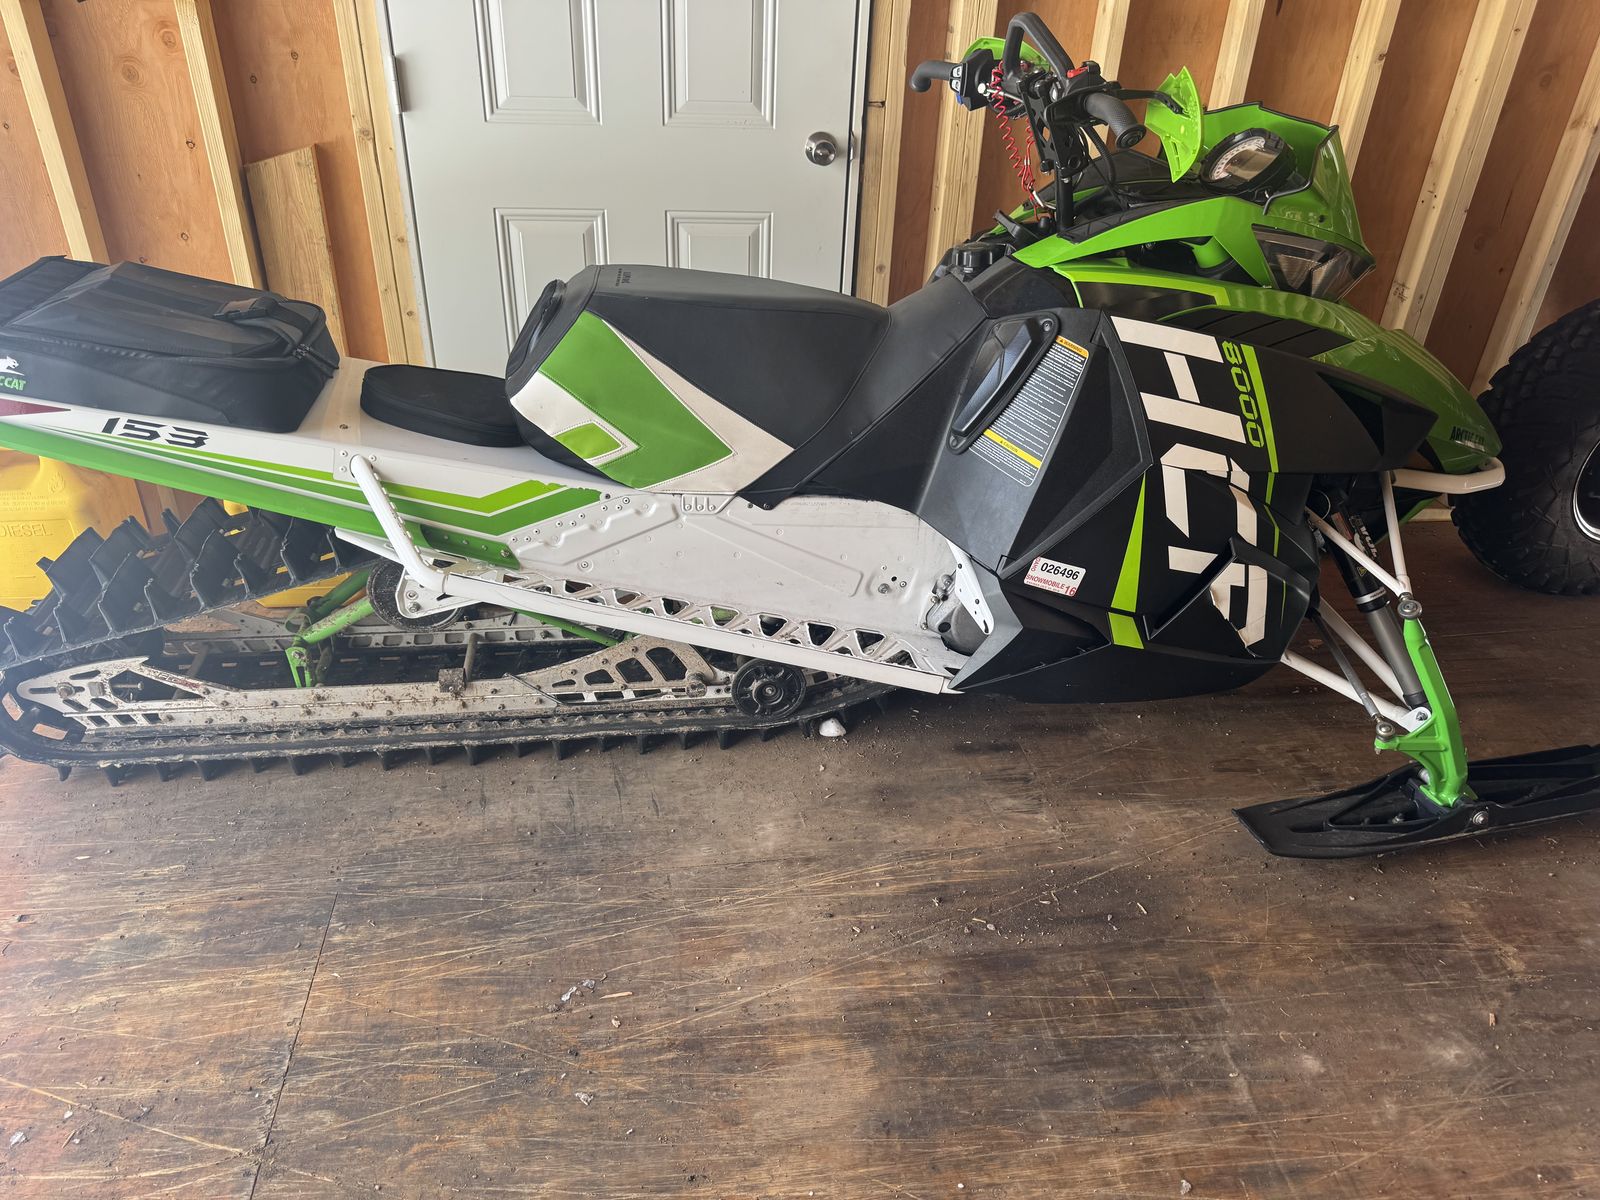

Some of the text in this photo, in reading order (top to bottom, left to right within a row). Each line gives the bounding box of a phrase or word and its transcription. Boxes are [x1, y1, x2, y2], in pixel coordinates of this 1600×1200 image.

[1221, 340, 1265, 448] 8000
[102, 417, 210, 449] 153
[1110, 315, 1268, 648] HCR
[1026, 574, 1065, 589] SNOWMOBILE
[1064, 585, 1077, 596] 16
[1041, 562, 1080, 580] 026496
